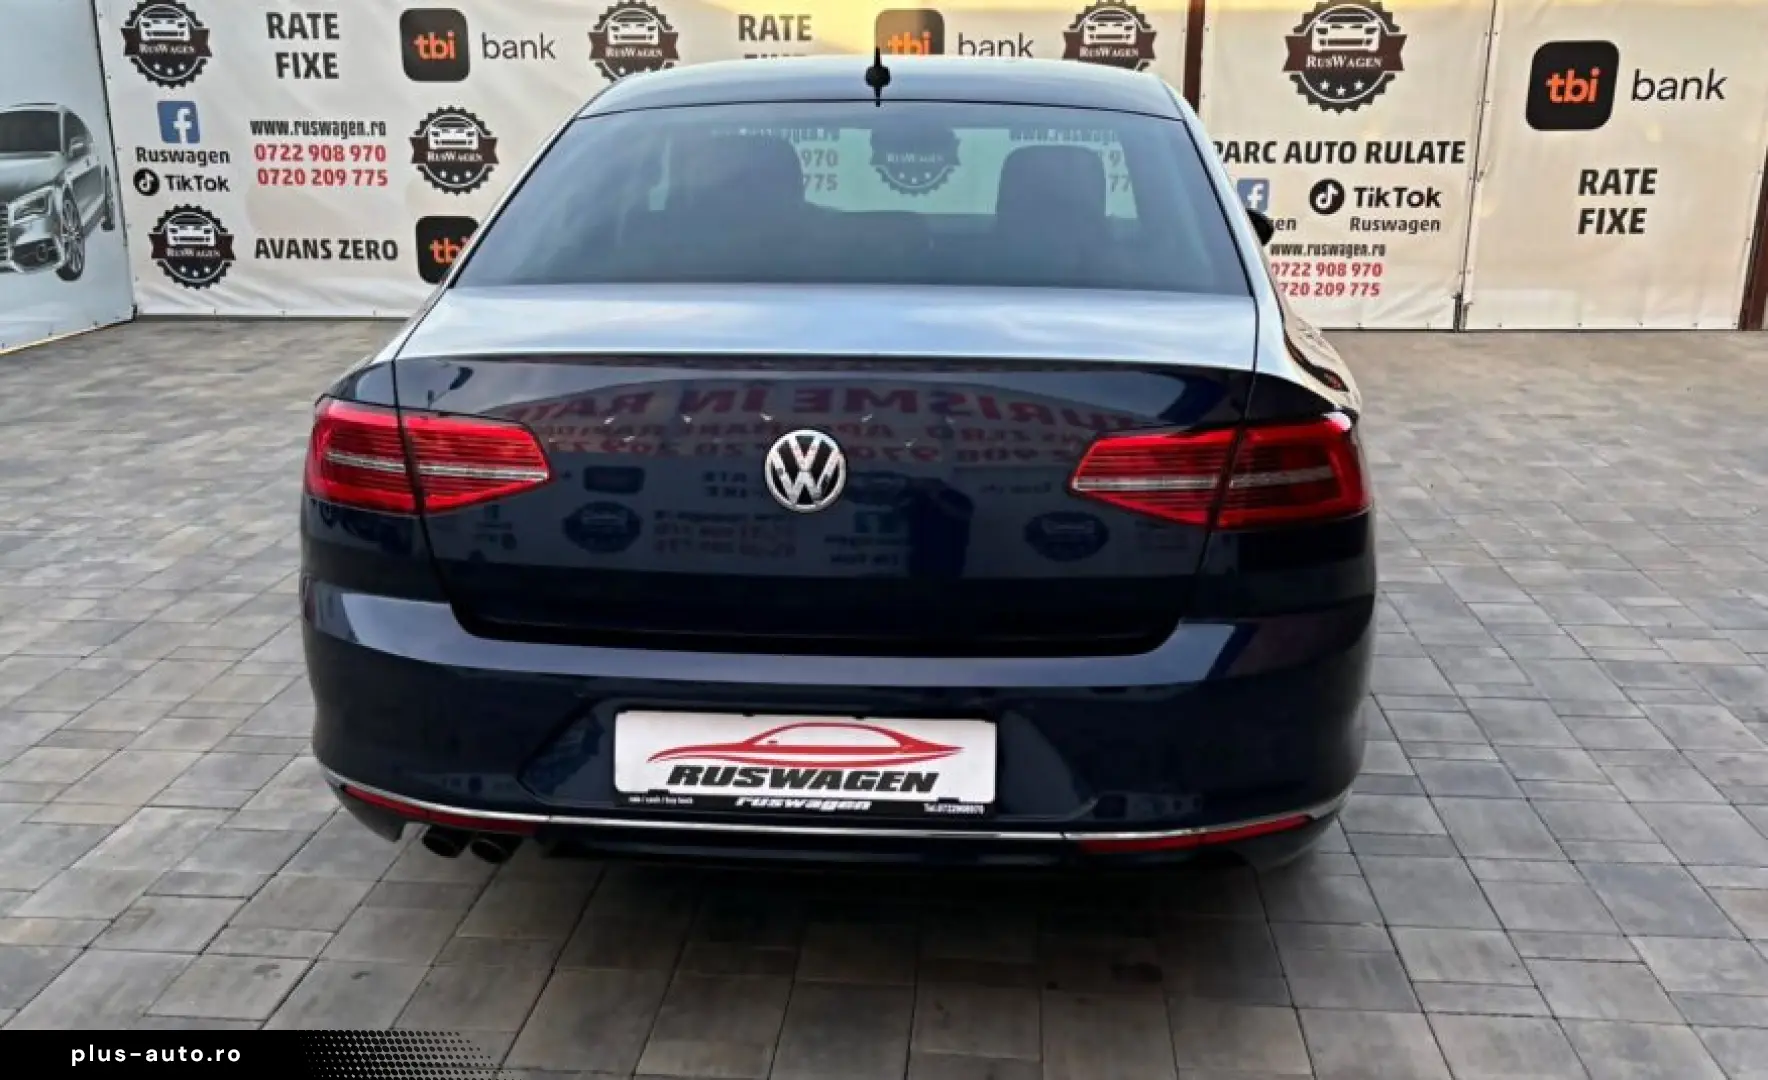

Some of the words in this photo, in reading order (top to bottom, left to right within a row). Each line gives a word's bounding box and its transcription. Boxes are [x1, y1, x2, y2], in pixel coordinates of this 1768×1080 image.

[266, 12, 340, 40] RATE
[738, 14, 813, 41] RATE
[413, 31, 456, 60] tbi
[482, 33, 556, 59] bank
[957, 32, 1034, 57] bank
[275, 52, 339, 79] FIXE
[1546, 67, 1601, 104] tbi
[1631, 68, 1728, 101] bank
[250, 120, 387, 139] www.ruswagen.ro
[136, 147, 230, 166] Ruswagen
[255, 145, 304, 162] 0722
[308, 145, 345, 162] 908
[350, 145, 387, 162] 970
[1283, 141, 1357, 164] AUTO
[1364, 140, 1466, 164] RULATE
[165, 175, 230, 192] TikTok
[257, 169, 306, 186] 0720
[310, 169, 347, 186] 209
[353, 169, 388, 186] 775
[1578, 168, 1657, 195] RATE
[1354, 186, 1442, 208] TikTok
[1349, 216, 1441, 234] Ruswagen
[1578, 208, 1647, 234] FIXE
[255, 238, 332, 260] AVANS
[338, 238, 398, 260] ZERO
[430, 236, 467, 264] tb
[1270, 243, 1386, 259] www.ruswagen.ro
[1315, 262, 1347, 277] 908
[1351, 262, 1383, 277] 970
[1279, 282, 1310, 297] 720
[1314, 282, 1345, 297] 209
[1350, 282, 1381, 297] 775
[667, 764, 939, 793] RUSWAGEN
[735, 796, 873, 812] ruswagen
